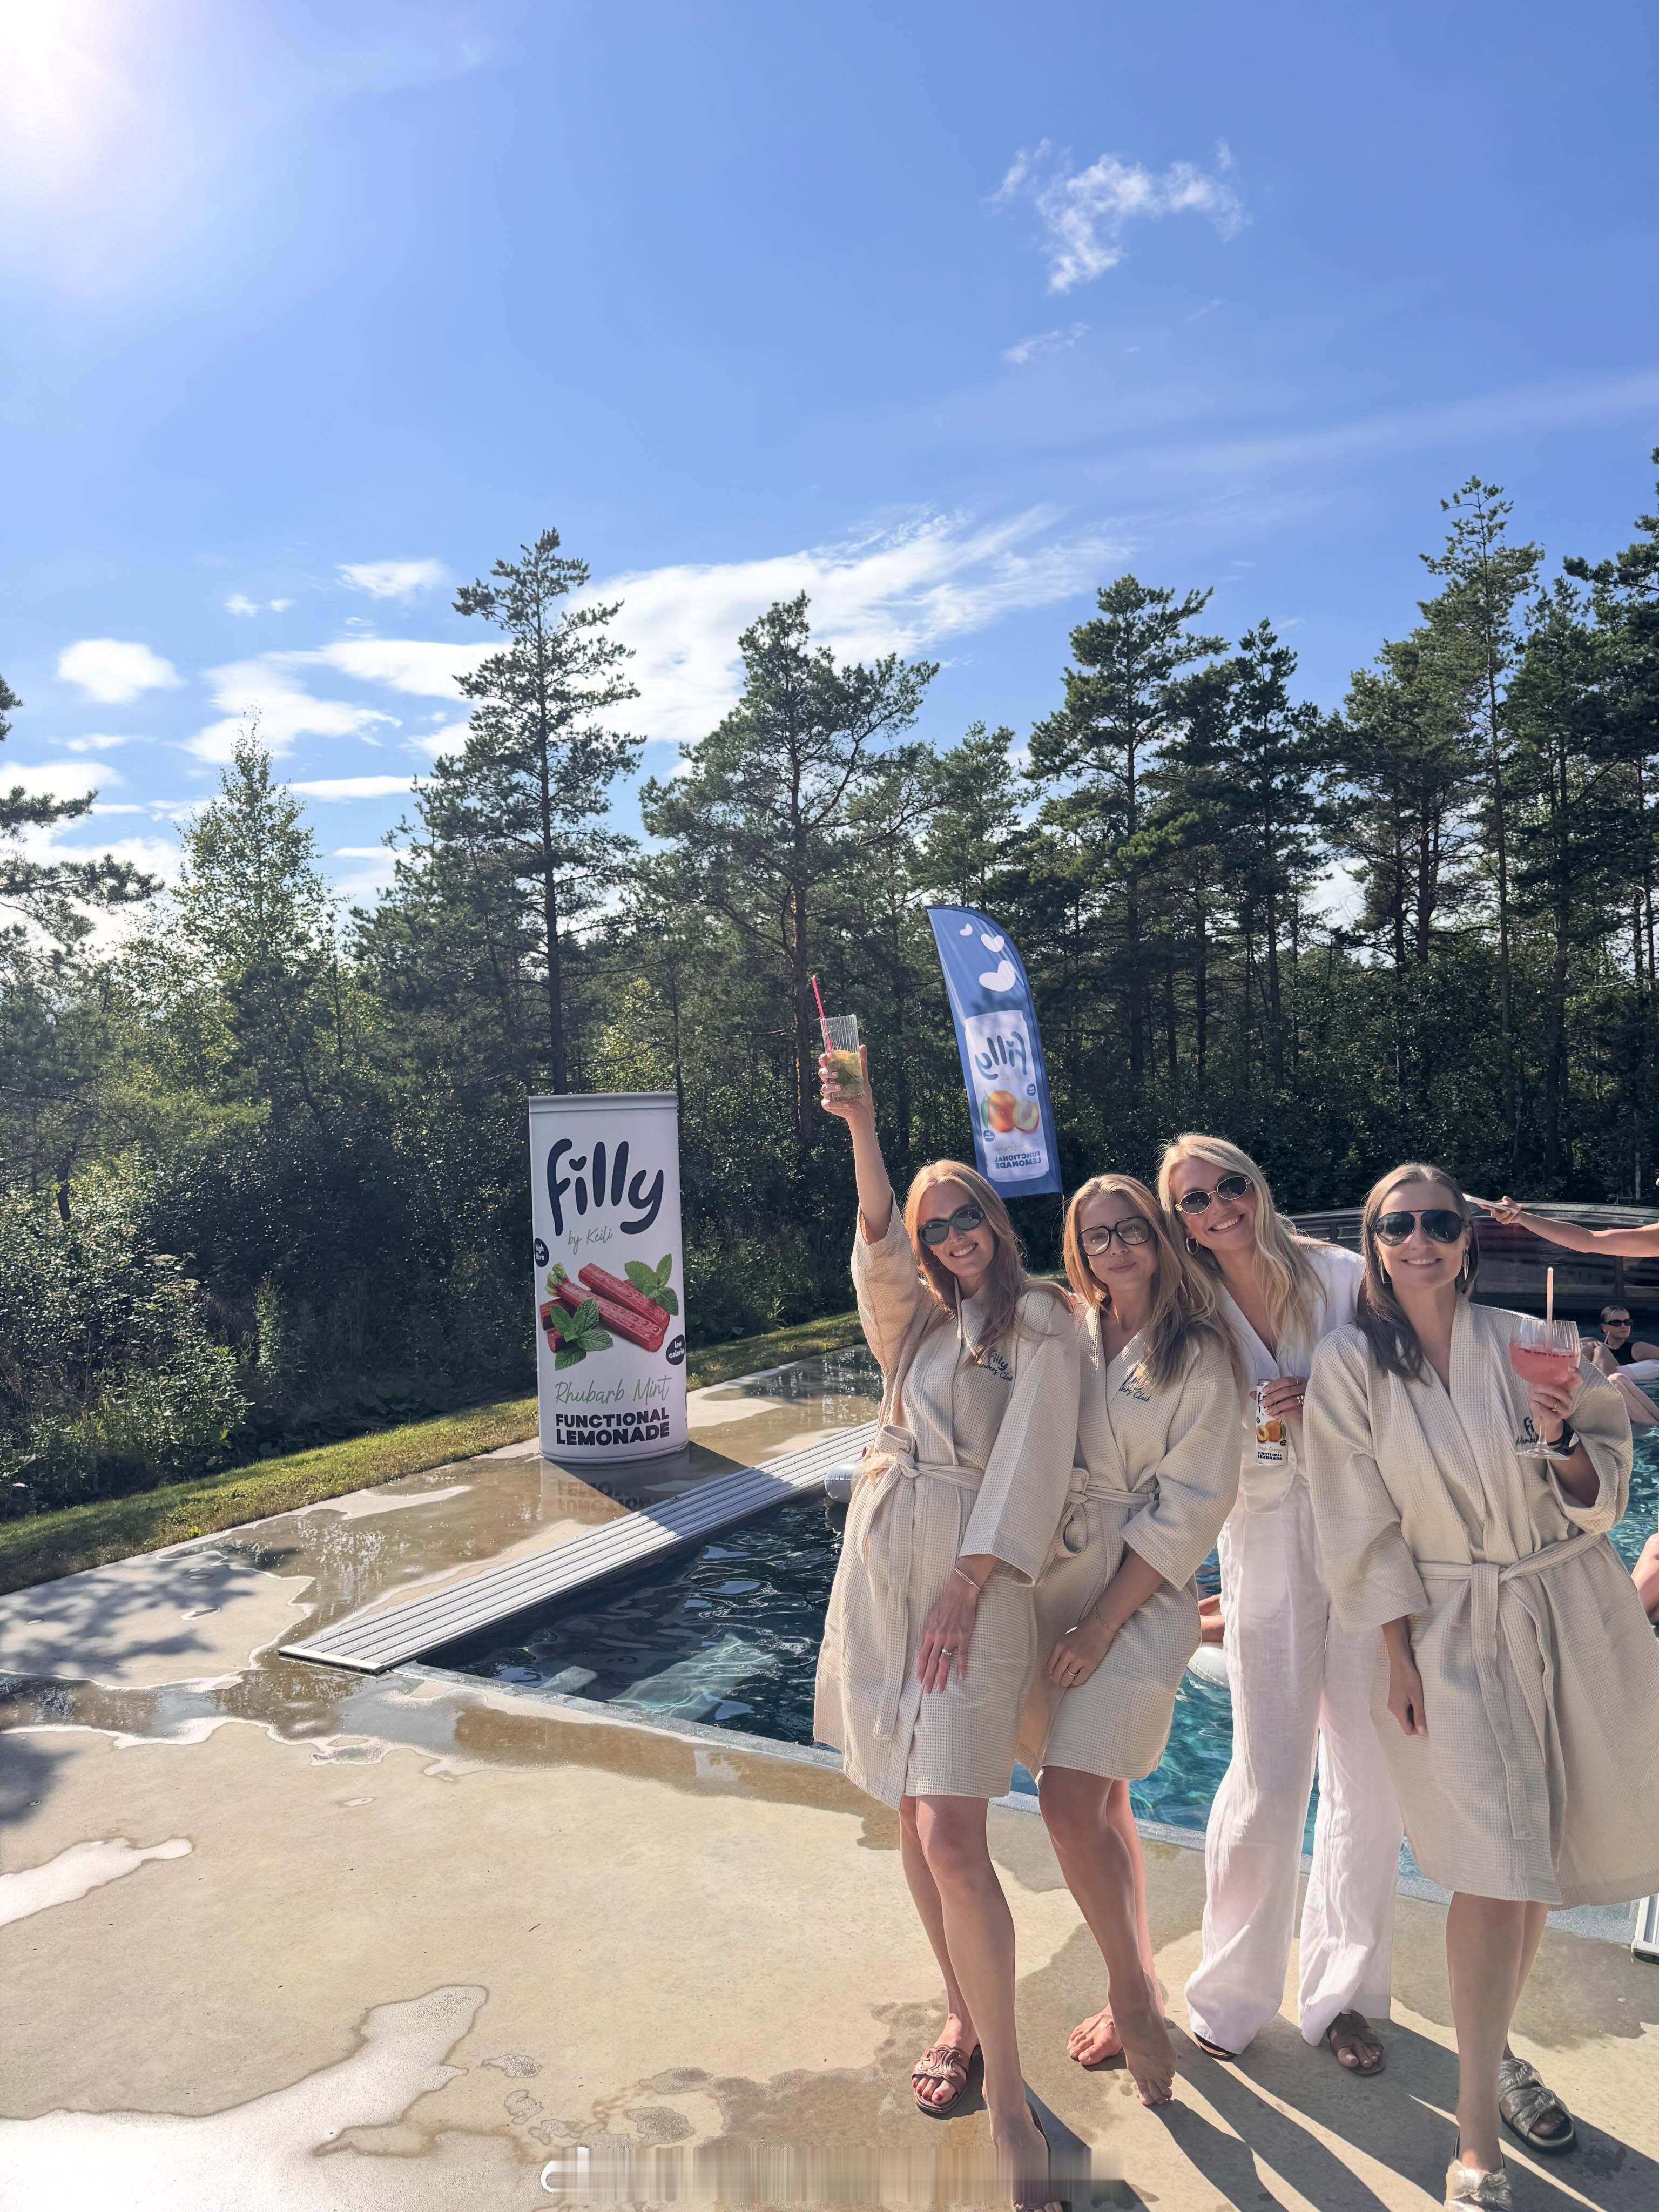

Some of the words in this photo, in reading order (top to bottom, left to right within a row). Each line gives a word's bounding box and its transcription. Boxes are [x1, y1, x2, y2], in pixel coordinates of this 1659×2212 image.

[547, 1138, 664, 1236] filly
[568, 1230, 582, 1255] by
[586, 1226, 613, 1244] Keili
[555, 1378, 625, 1405] Rhubarb
[633, 1375, 672, 1405] Mint
[1133, 1391, 1151, 1402] Club
[556, 1407, 670, 1428] FUNCTIONAL
[556, 1421, 670, 1446] LEMONADE
